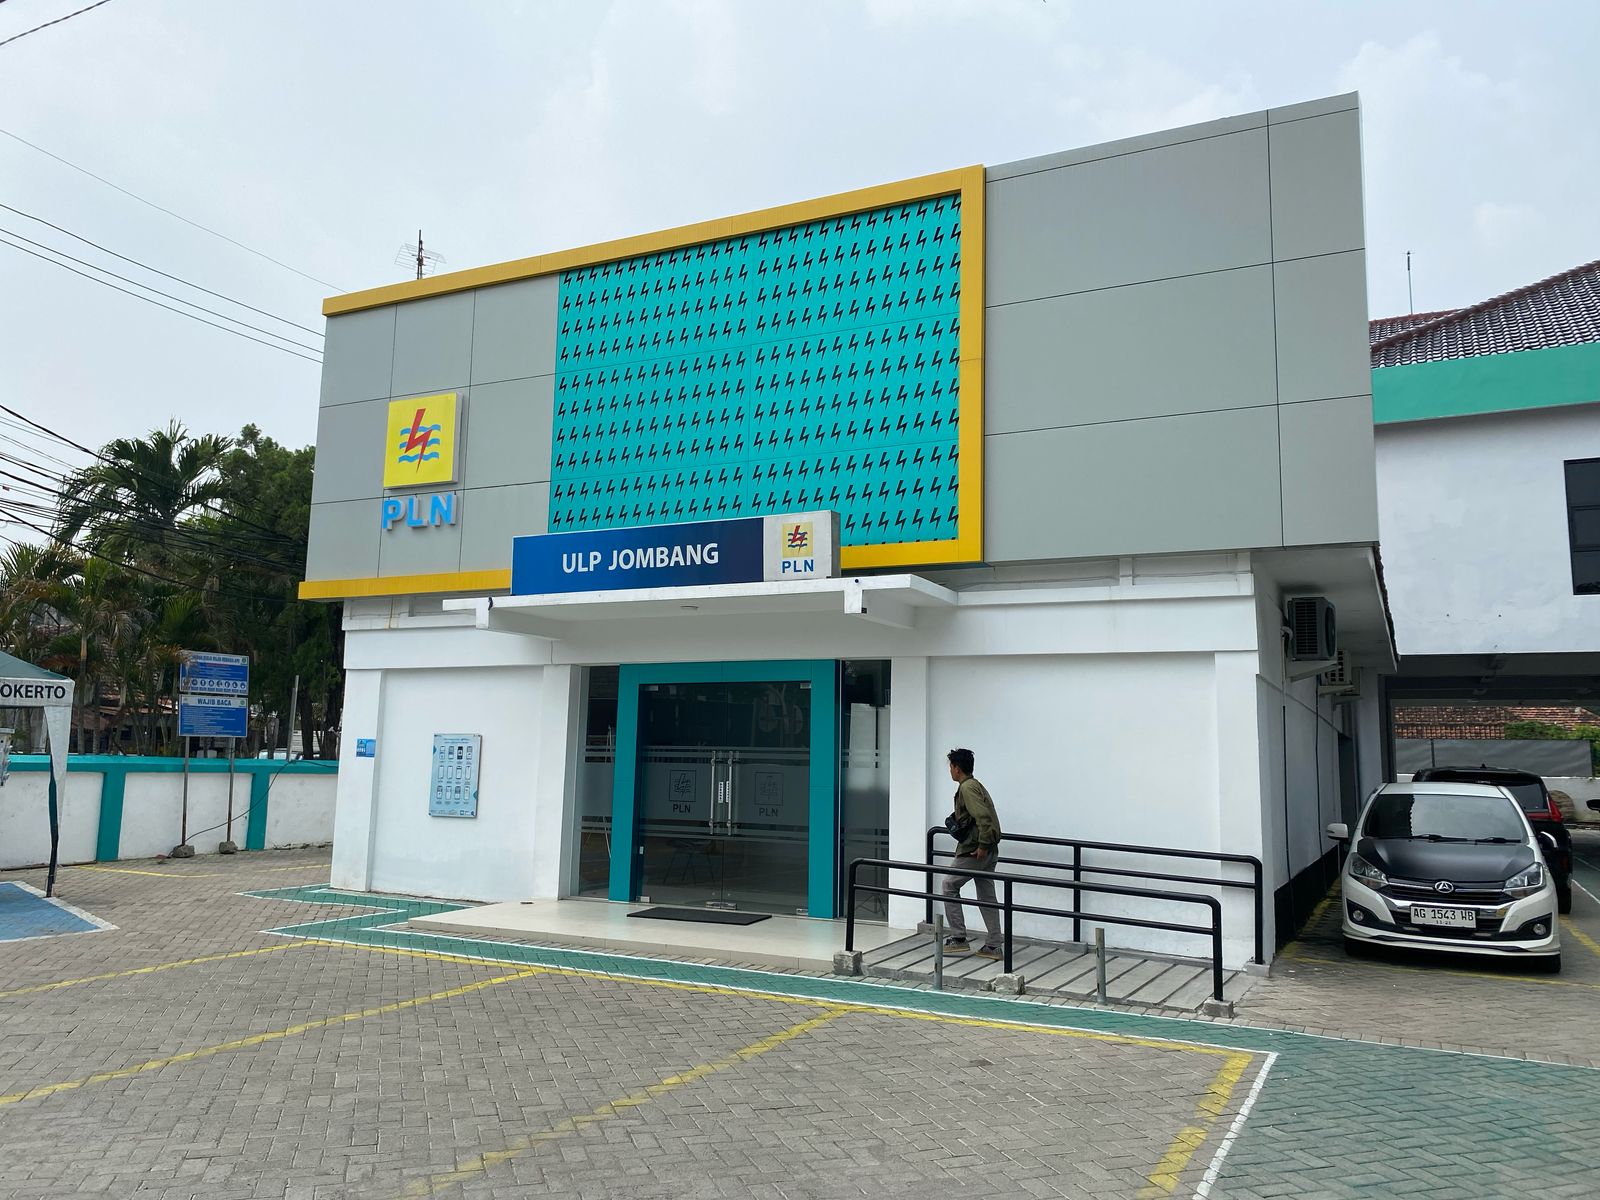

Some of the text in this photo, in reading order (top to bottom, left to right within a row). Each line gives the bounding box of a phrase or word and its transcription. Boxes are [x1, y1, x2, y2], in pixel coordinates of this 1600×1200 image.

[382, 493, 456, 530] PLN
[562, 543, 719, 574] ULP JOMBANG
[782, 559, 814, 574] PLN
[0, 684, 66, 699] OKERTO
[672, 804, 691, 813] PLN
[759, 808, 778, 817] PLN
[1413, 908, 1426, 919] AG
[1431, 909, 1456, 920] 1543
